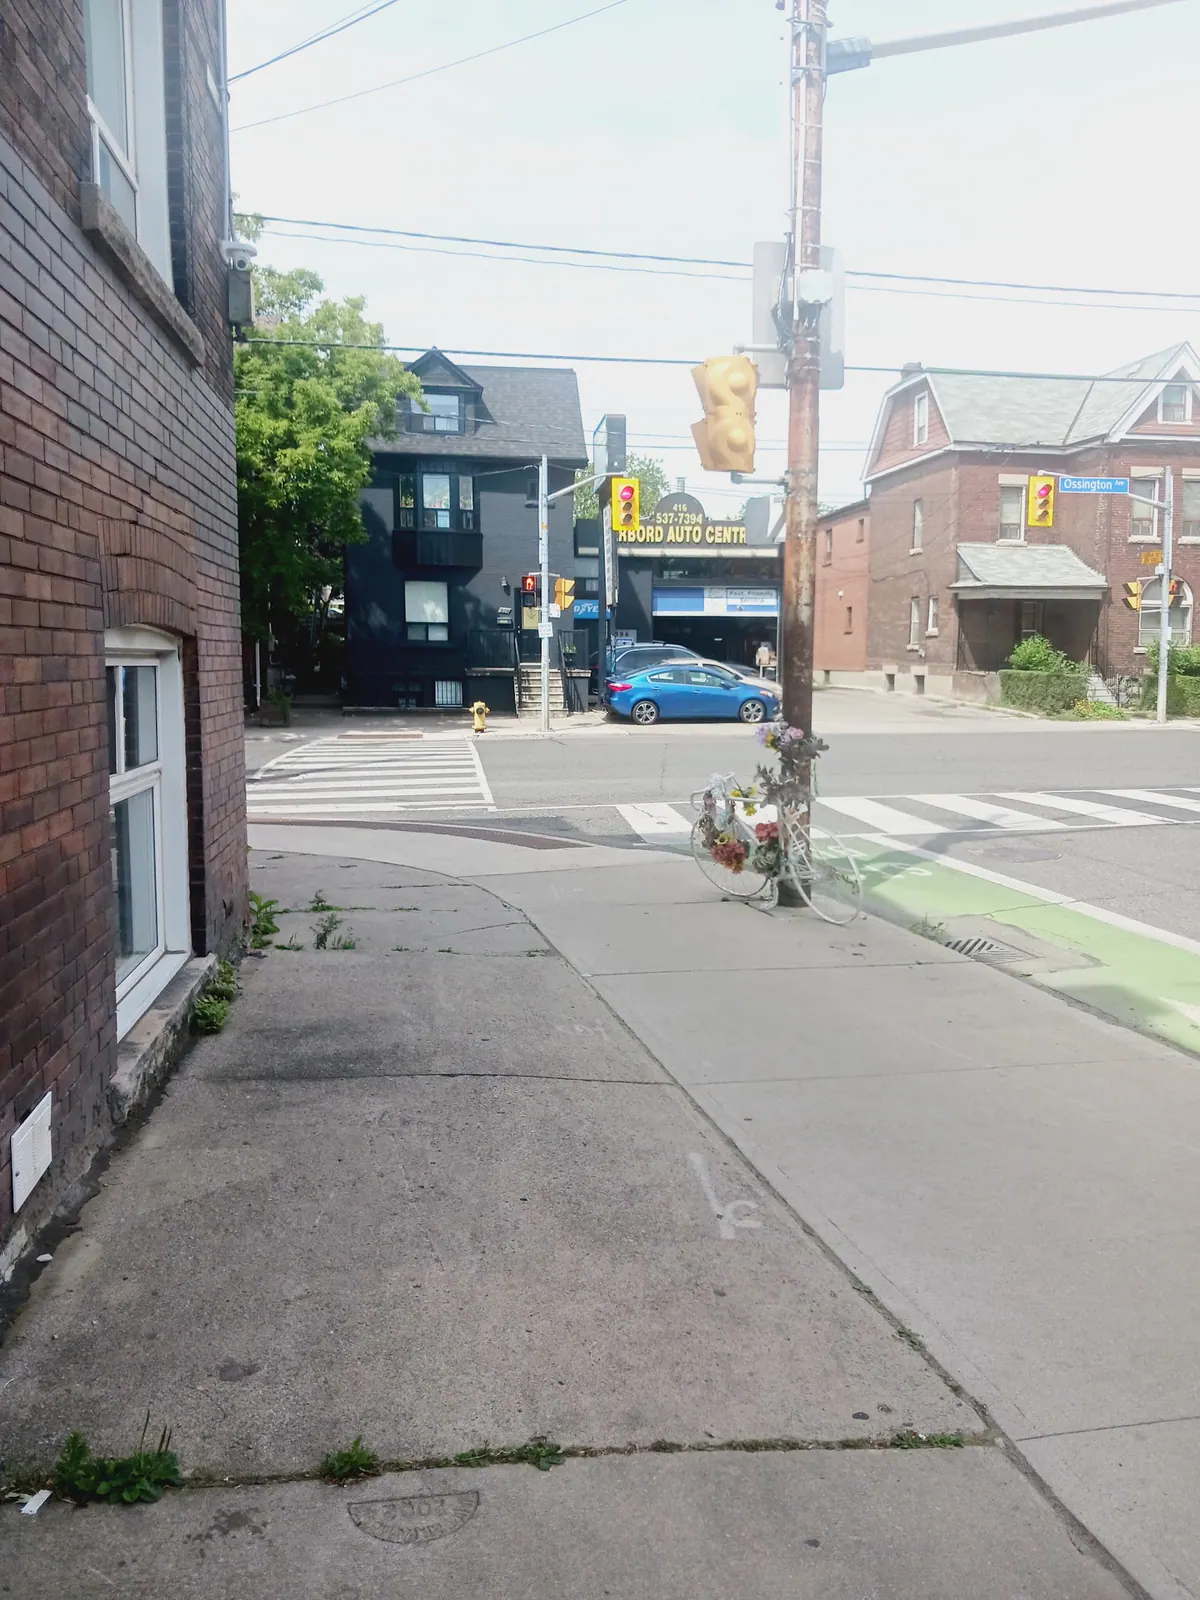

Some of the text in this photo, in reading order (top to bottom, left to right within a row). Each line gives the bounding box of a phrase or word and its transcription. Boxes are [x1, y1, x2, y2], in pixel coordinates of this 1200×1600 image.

[1063, 478, 1113, 492] Ossington
[672, 503, 688, 512] 416
[656, 513, 703, 525] 537-7394
[617, 525, 747, 544] RBORD AUTO CENTR
